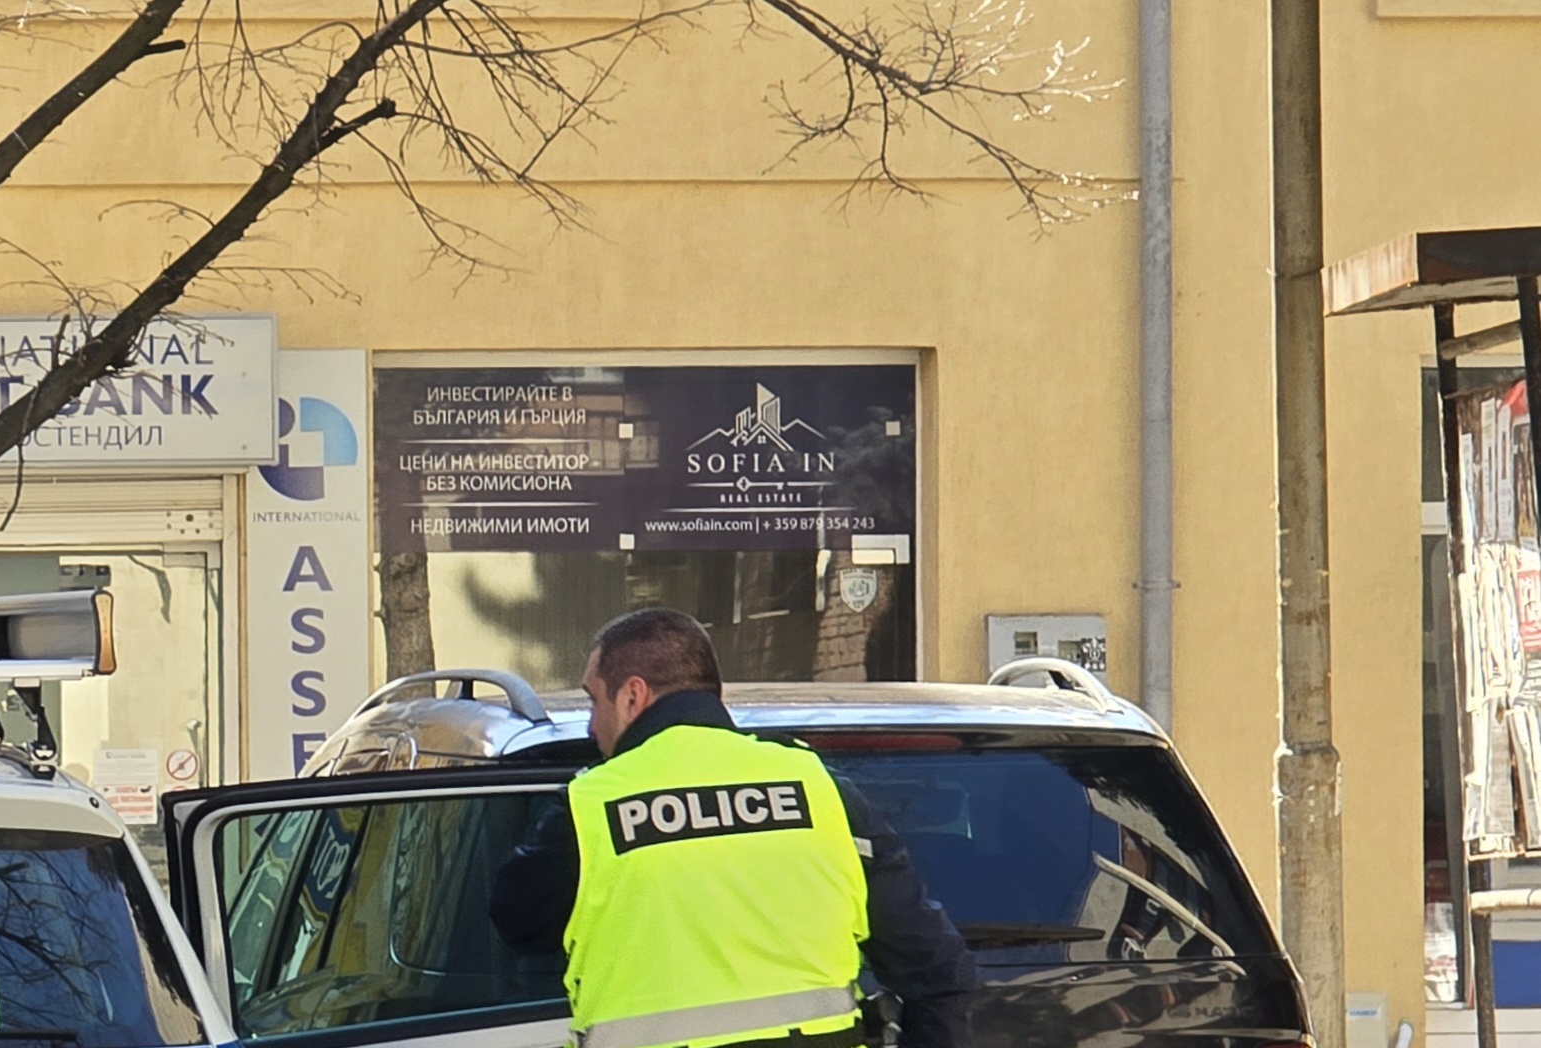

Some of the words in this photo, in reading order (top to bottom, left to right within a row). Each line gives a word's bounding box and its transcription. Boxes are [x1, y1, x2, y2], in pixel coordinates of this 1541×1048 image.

[57, 374, 219, 416] ANK
[427, 384, 557, 402] ИНВЕСТИРАЙТЕ
[562, 386, 573, 401] В
[413, 409, 500, 425] БЪЛГАРИЯ
[504, 407, 516, 424] И
[521, 408, 586, 427] ГЪРЦИЯ
[22, 425, 162, 450] СТЕНДИЛ
[399, 455, 447, 473] ЦЕНИ
[451, 454, 475, 470] НА
[479, 454, 589, 470] ИНВЕСТИТОР
[687, 453, 786, 473] SOFIA
[804, 452, 835, 471] IN
[426, 476, 456, 491] БЕЗ
[460, 475, 572, 491] КОМИСИОНА
[758, 493, 801, 503] ESTATE
[253, 511, 361, 522] INTERNATIONAL
[645, 518, 753, 531] www.sofiain.com
[774, 518, 797, 530] 359
[826, 517, 849, 530] 354
[852, 517, 875, 529] 243
[411, 518, 523, 536] НЕДВИЖИМИ
[527, 517, 590, 533] ИМОТИ
[617, 788, 802, 842] POLICE
